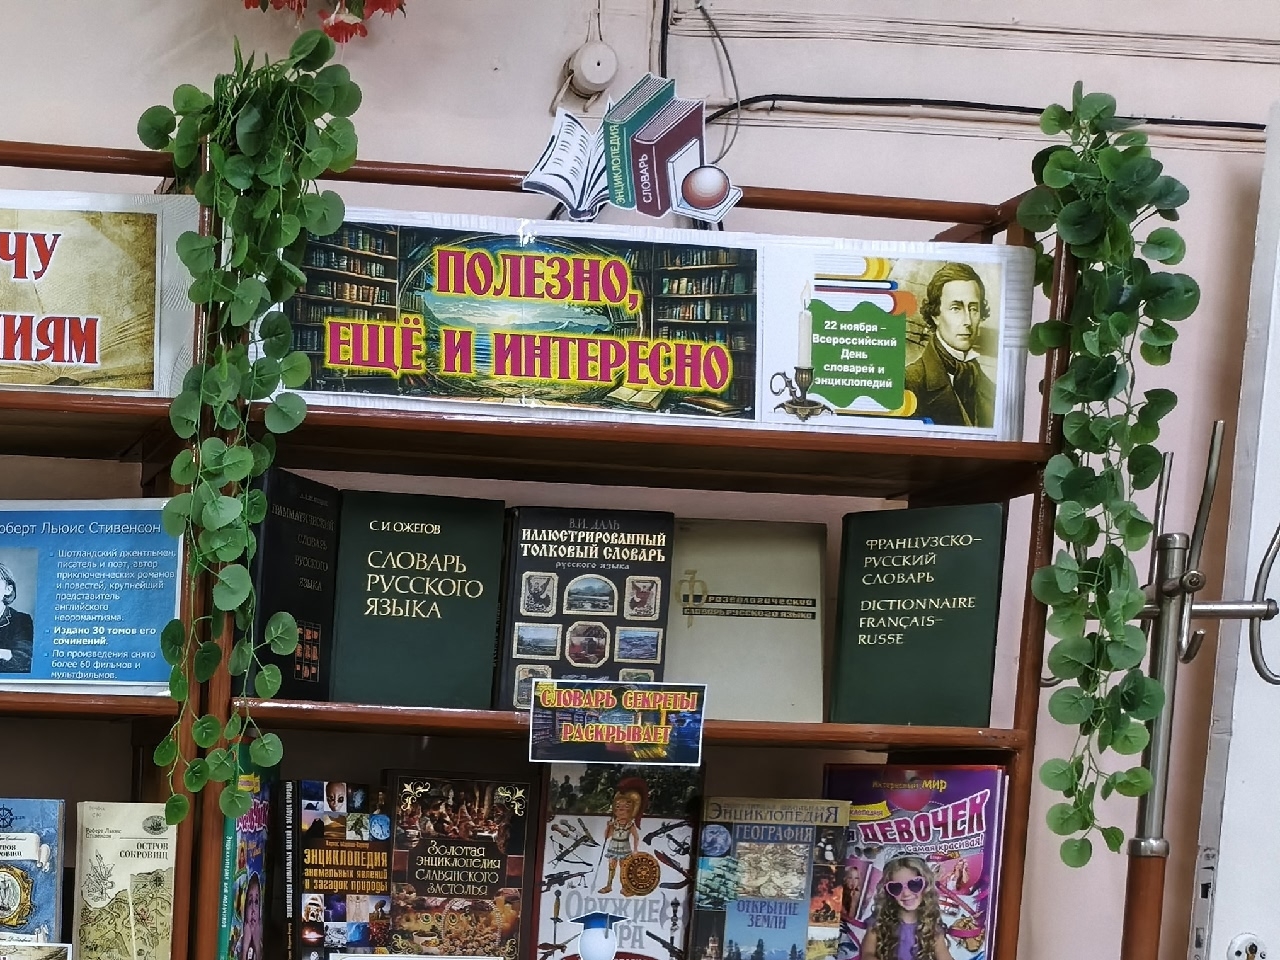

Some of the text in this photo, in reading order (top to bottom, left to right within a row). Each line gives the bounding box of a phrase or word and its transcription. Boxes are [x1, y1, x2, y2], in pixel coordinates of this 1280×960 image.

[609, 124, 625, 204] ЭНЦИКЛОПЕДИЯ
[639, 154, 652, 203] СЛОВАРЬ
[435, 249, 640, 310] ПОЛЕЗНО,
[824, 321, 877, 333] 22 ноября
[813, 334, 897, 347] Всероссийский
[326, 316, 730, 391] ЕЩЁ И ИНТЕРЕСНО
[841, 349, 868, 360] День
[823, 364, 875, 374] словарей
[815, 377, 893, 389] энциклопедий
[41, 523, 84, 534] Льюис
[89, 522, 161, 533] Стивенсон
[393, 522, 440, 534] ОЖЕГОВ
[522, 529, 666, 546] ИЛЛЮСТРИРОВАННЫЙ
[866, 534, 982, 550] ФРАНЦУЗСКО-
[521, 544, 665, 562] ТОЛКОВЫЙ СЛОВАРЬ
[864, 553, 937, 568] РУССКИЙ
[368, 551, 467, 573] СЛОВАРЬ
[367, 574, 483, 598] РУССКОГО
[862, 572, 934, 585] СЛОВАРЬ
[364, 598, 442, 618] ЯЗЫКА
[861, 597, 976, 611] DICTIONNAIRE
[859, 616, 943, 629] FRANÇAIS-
[53, 637, 108, 645] сочинений.
[858, 634, 904, 645] RUSSE
[540, 689, 698, 710] СЛОВАРЬ СЕКРЕТЫ
[562, 724, 671, 743] РАСКРЫВАЕТ
[859, 789, 990, 845] ДЕВОЧЕК
[736, 825, 813, 842] ГЕОГРАФИЯ
[304, 848, 388, 867] ЭНЦИКЛОПЕДИЯ
[737, 900, 799, 915] ОТКРЫТИЕ
[747, 913, 787, 930] ЗЕМЛИ
